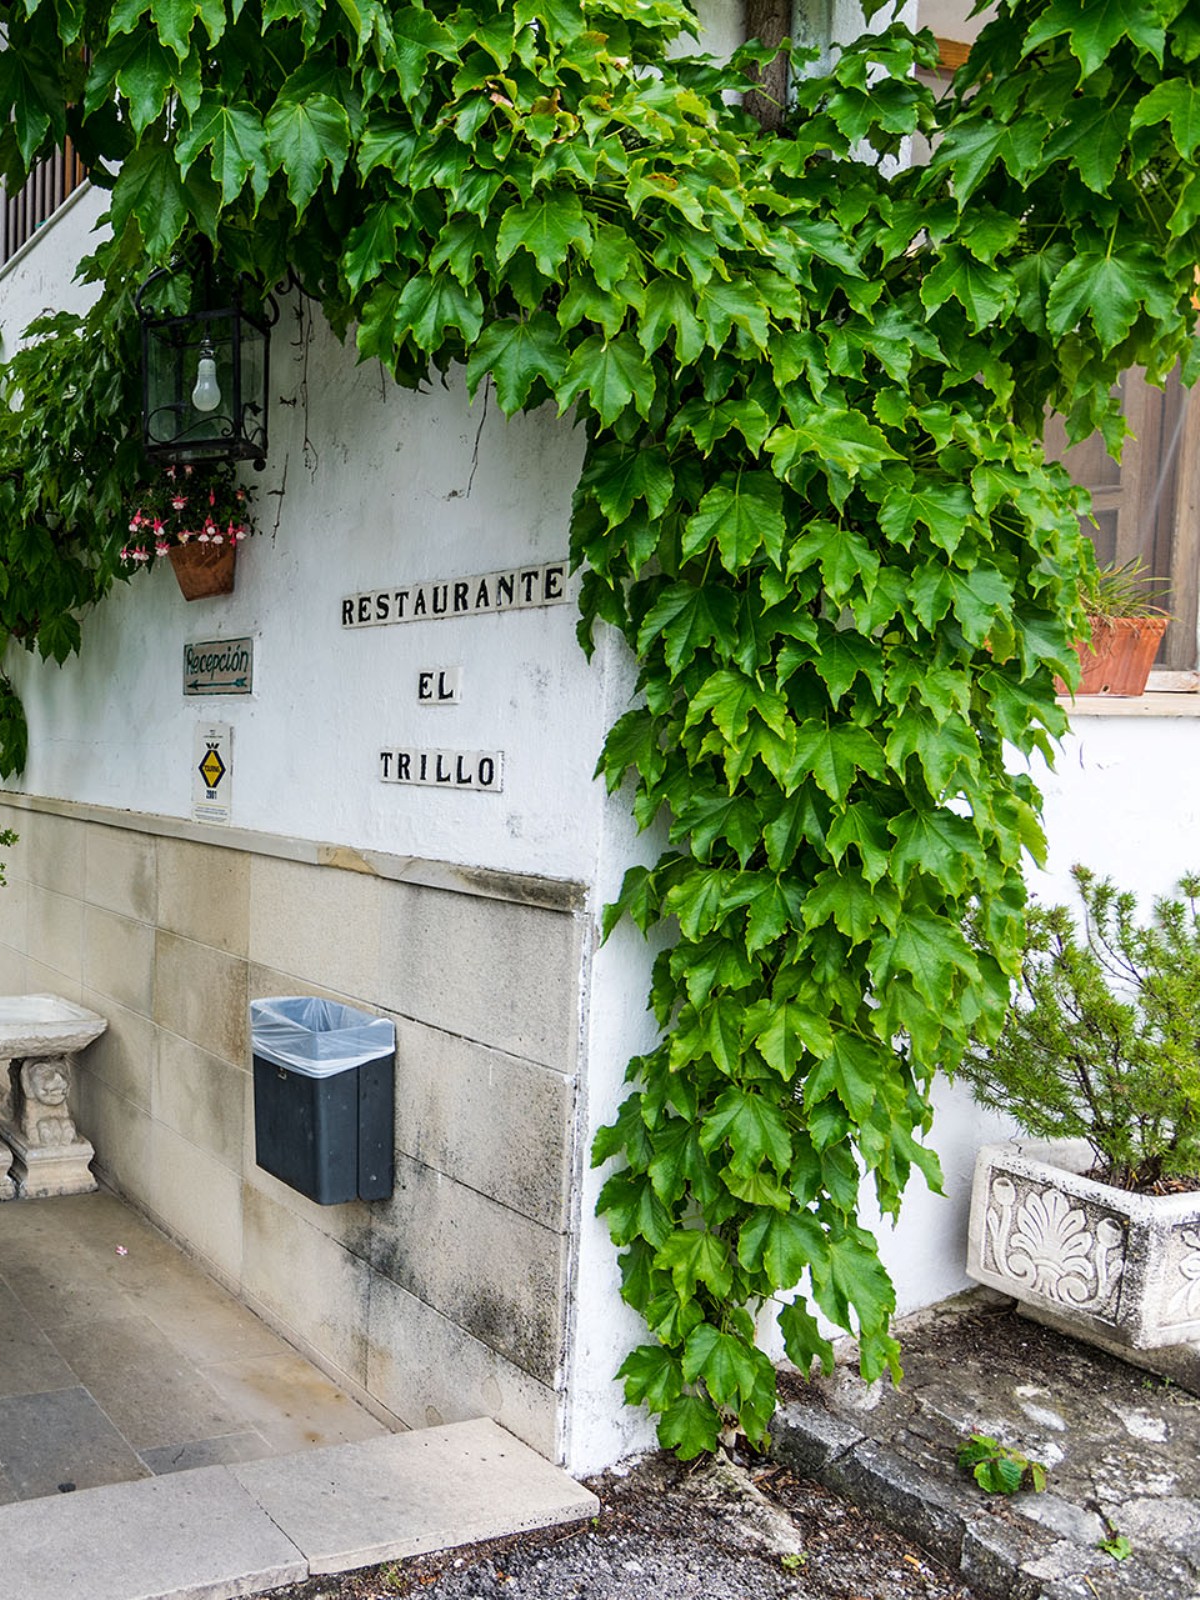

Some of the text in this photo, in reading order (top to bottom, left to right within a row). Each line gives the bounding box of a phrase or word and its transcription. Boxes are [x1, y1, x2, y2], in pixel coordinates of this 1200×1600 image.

[342, 567, 564, 625] RESTAURANTE
[186, 644, 249, 680] Recepción
[418, 671, 453, 700] EL
[380, 752, 494, 786] TRILLO
